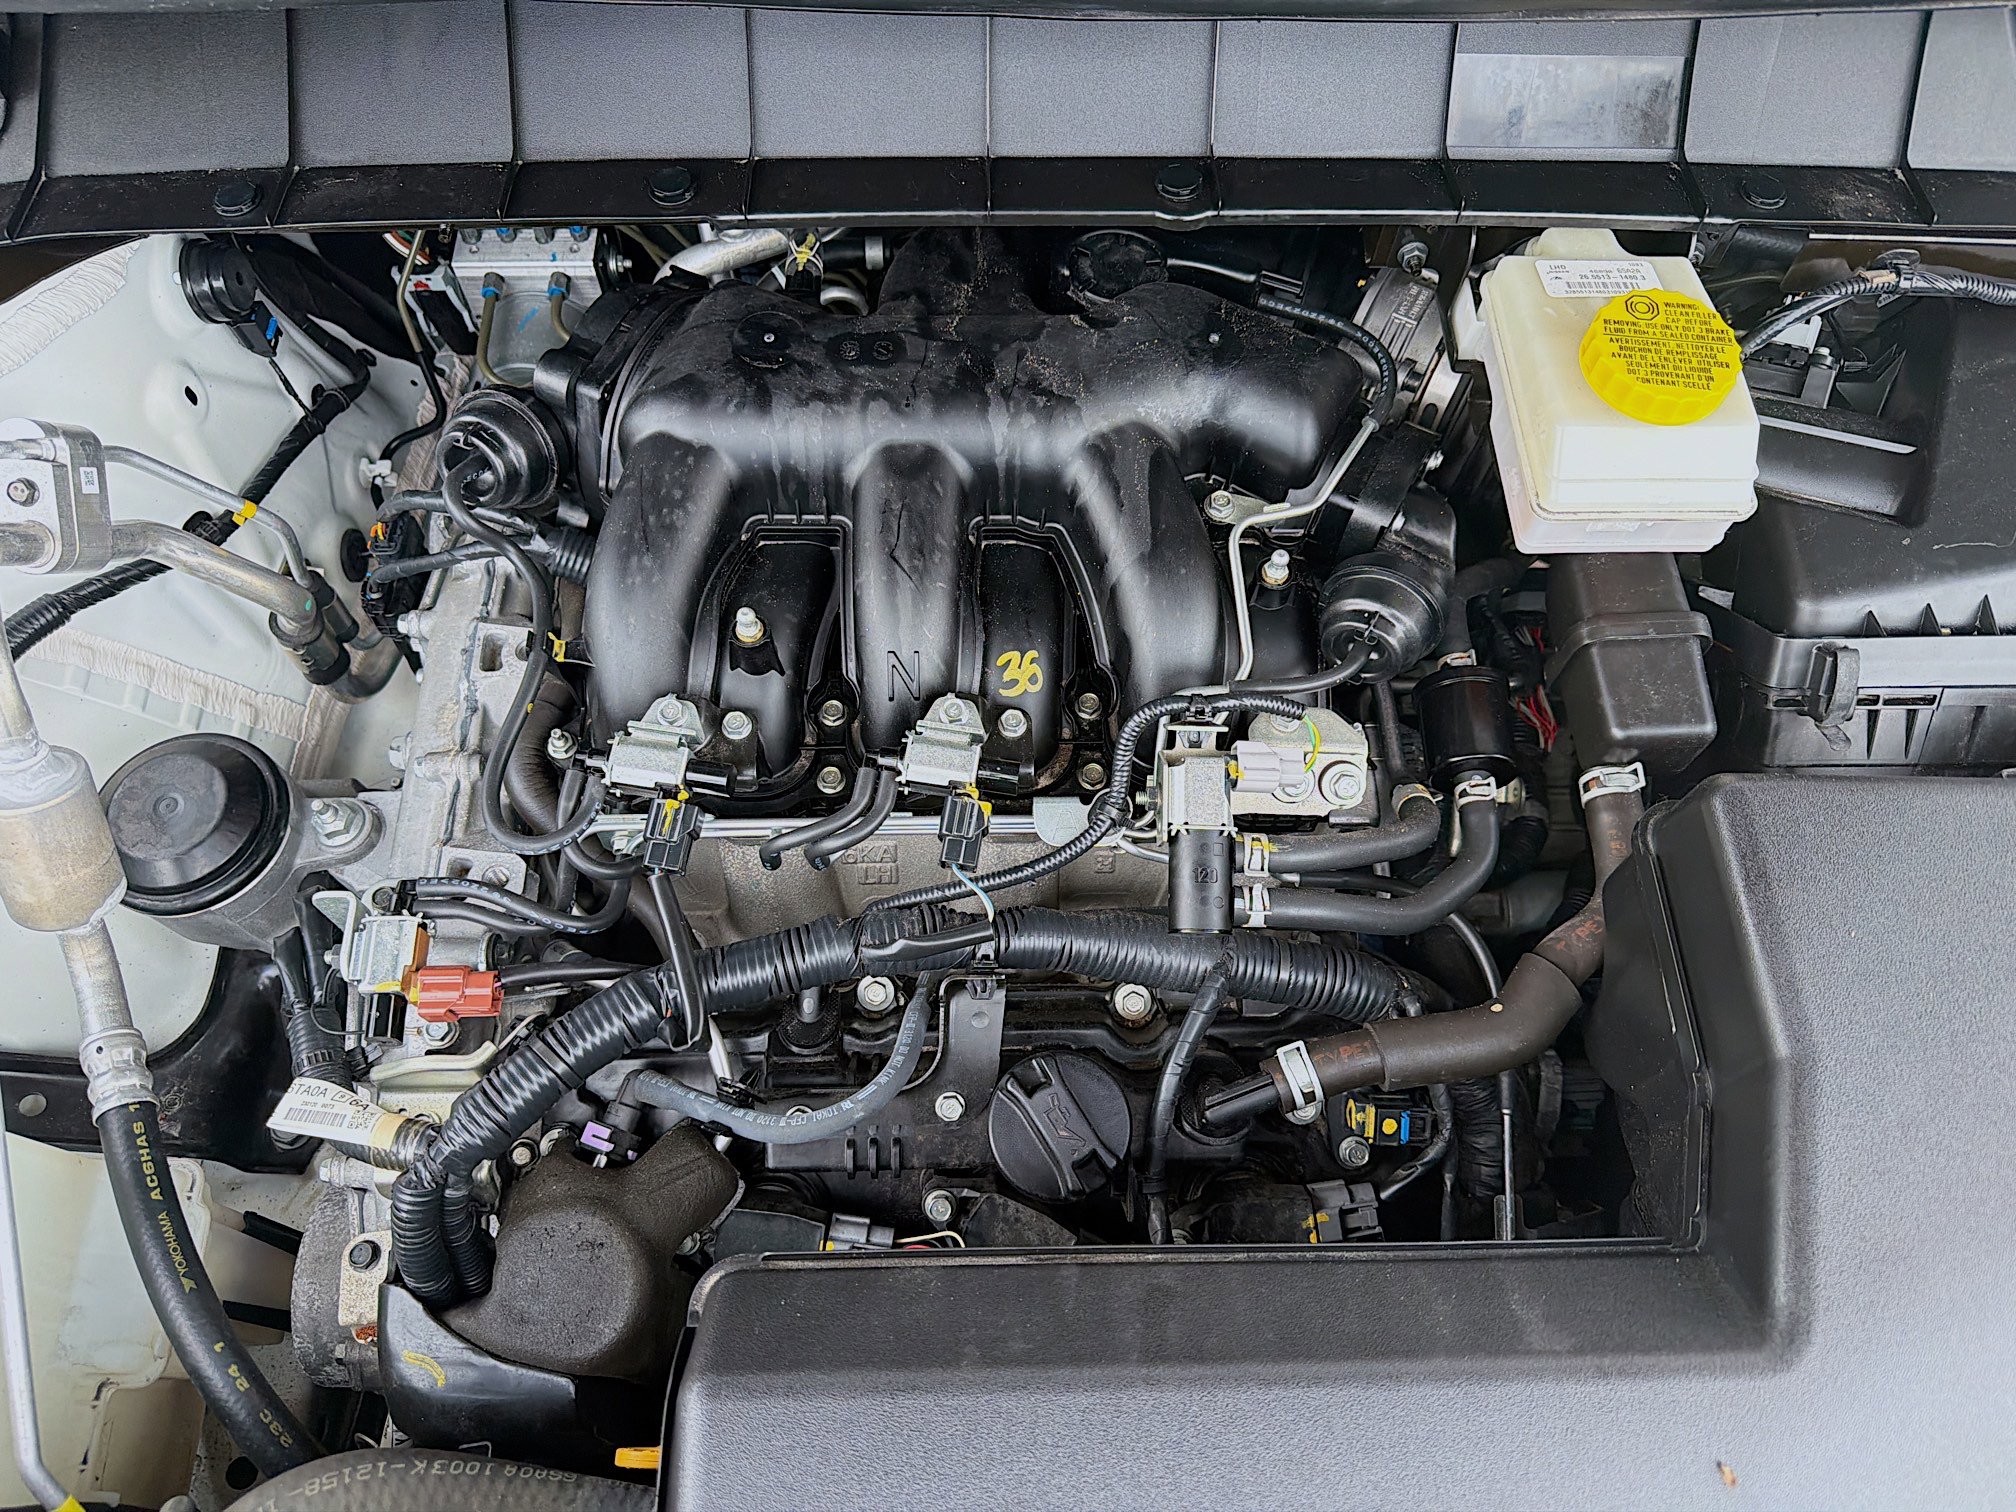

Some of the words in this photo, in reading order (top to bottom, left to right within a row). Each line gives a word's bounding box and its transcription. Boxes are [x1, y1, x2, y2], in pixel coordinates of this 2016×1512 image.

[1663, 301, 1700, 311] WARNING:
[1664, 310, 1691, 318] CLEAN
[1691, 311, 1717, 320] FILLER
[1666, 317, 1681, 325] CAP
[1685, 318, 1713, 327] BEFORE
[1604, 326, 1626, 334] FLUID
[1628, 328, 1650, 337] FROM
[1659, 331, 1690, 340] SEALED
[1691, 334, 1733, 344] CONTAINER
[1660, 323, 1680, 332] ONLY
[1682, 325, 1696, 333] DOT
[1705, 328, 1730, 336] BRAKE
[1618, 345, 1653, 354] BOUCHON
[1665, 349, 1719, 360] REMPLISSAGE
[1676, 341, 1716, 352] NETTOYER
[1716, 346, 1726, 354] LE
[1611, 352, 1639, 360] AVANT
[1697, 360, 1731, 369] UTILISER
[1625, 360, 1670, 371] SEULEMENT
[1684, 365, 1713, 374] LIQUIDE
[1636, 376, 1681, 387] CONTENANT
[1650, 370, 1696, 381] PROVENANT
[886, 650, 921, 702] N
[996, 649, 1044, 698] 36
[863, 865, 894, 884] LH
[731, 1107, 744, 1119] NOT
[756, 1115, 775, 1127] 3120
[157, 1210, 189, 1277] YOKOHAMA
